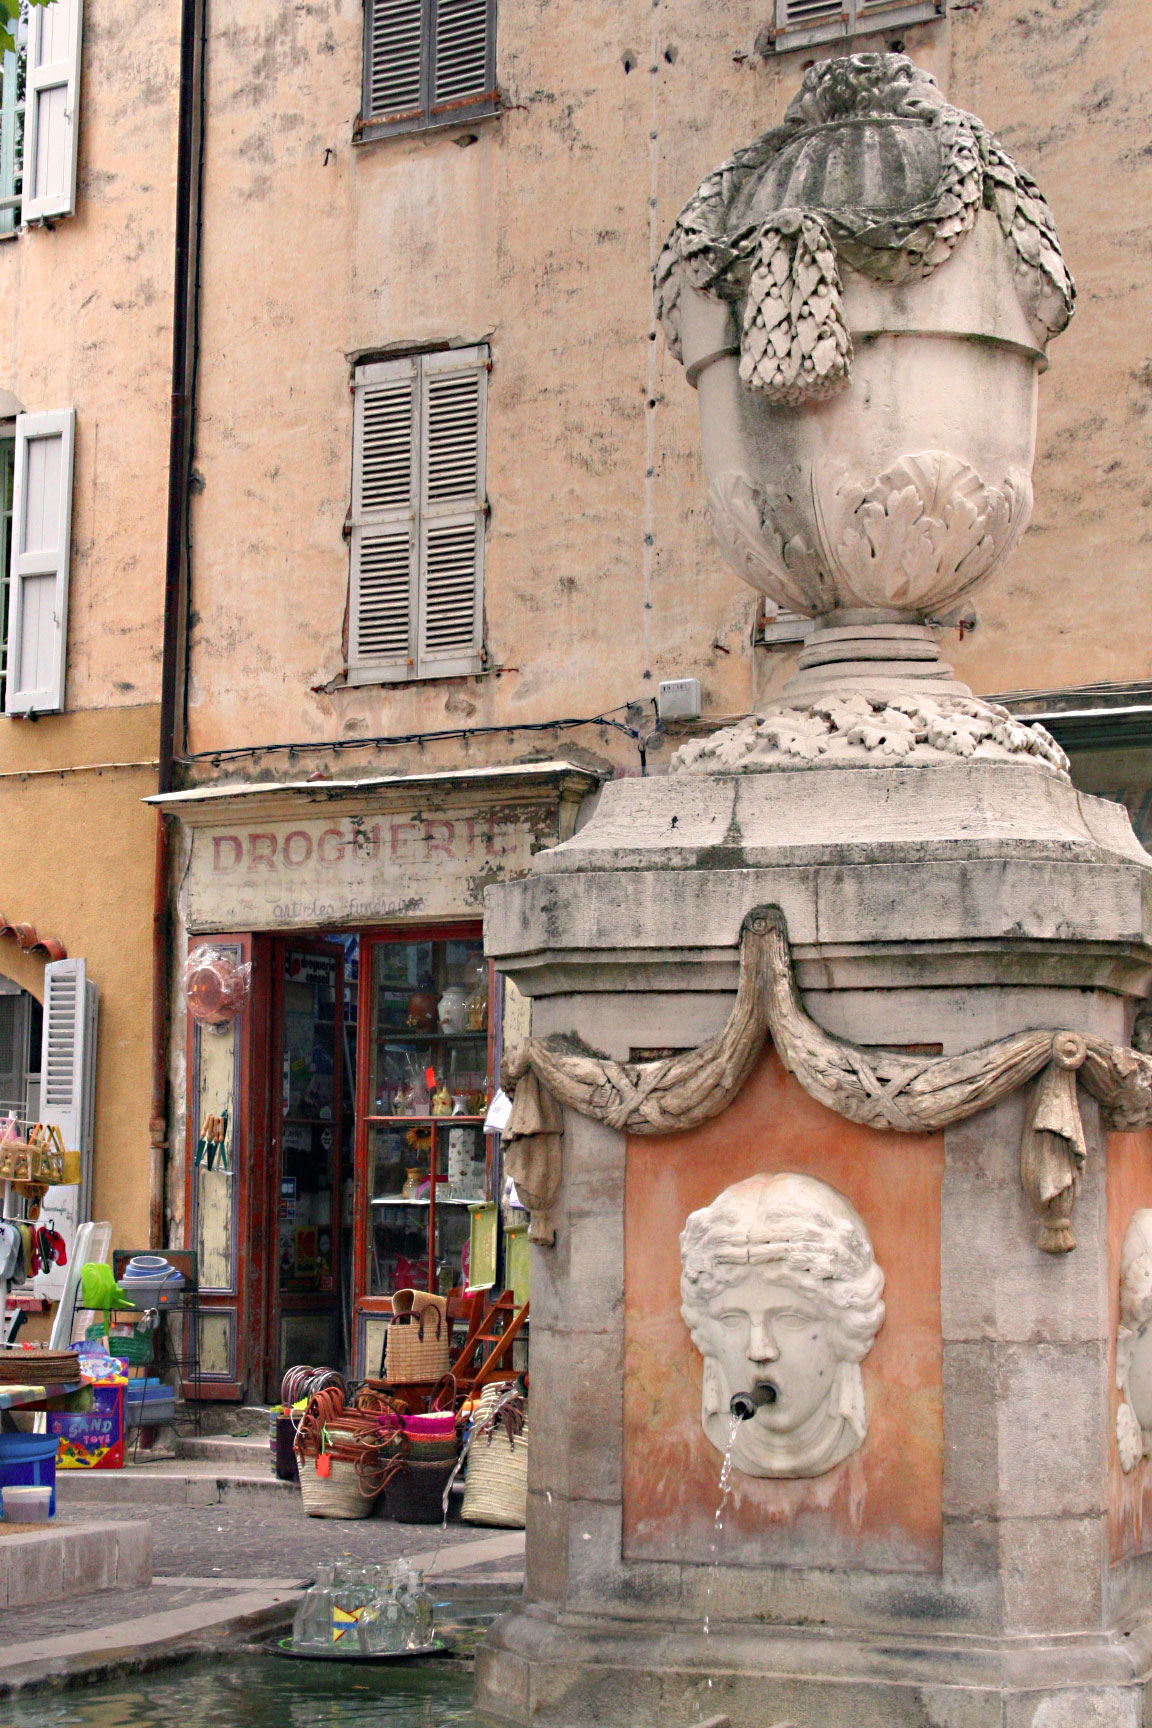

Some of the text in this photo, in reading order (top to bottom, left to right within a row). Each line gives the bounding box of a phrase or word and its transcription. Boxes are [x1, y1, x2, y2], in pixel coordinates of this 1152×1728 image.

[211, 818, 516, 873] DROGUERIE
[305, 972, 330, 986] conseil
[68, 1418, 112, 1438] SAND
[83, 1434, 110, 1445] TOYS
